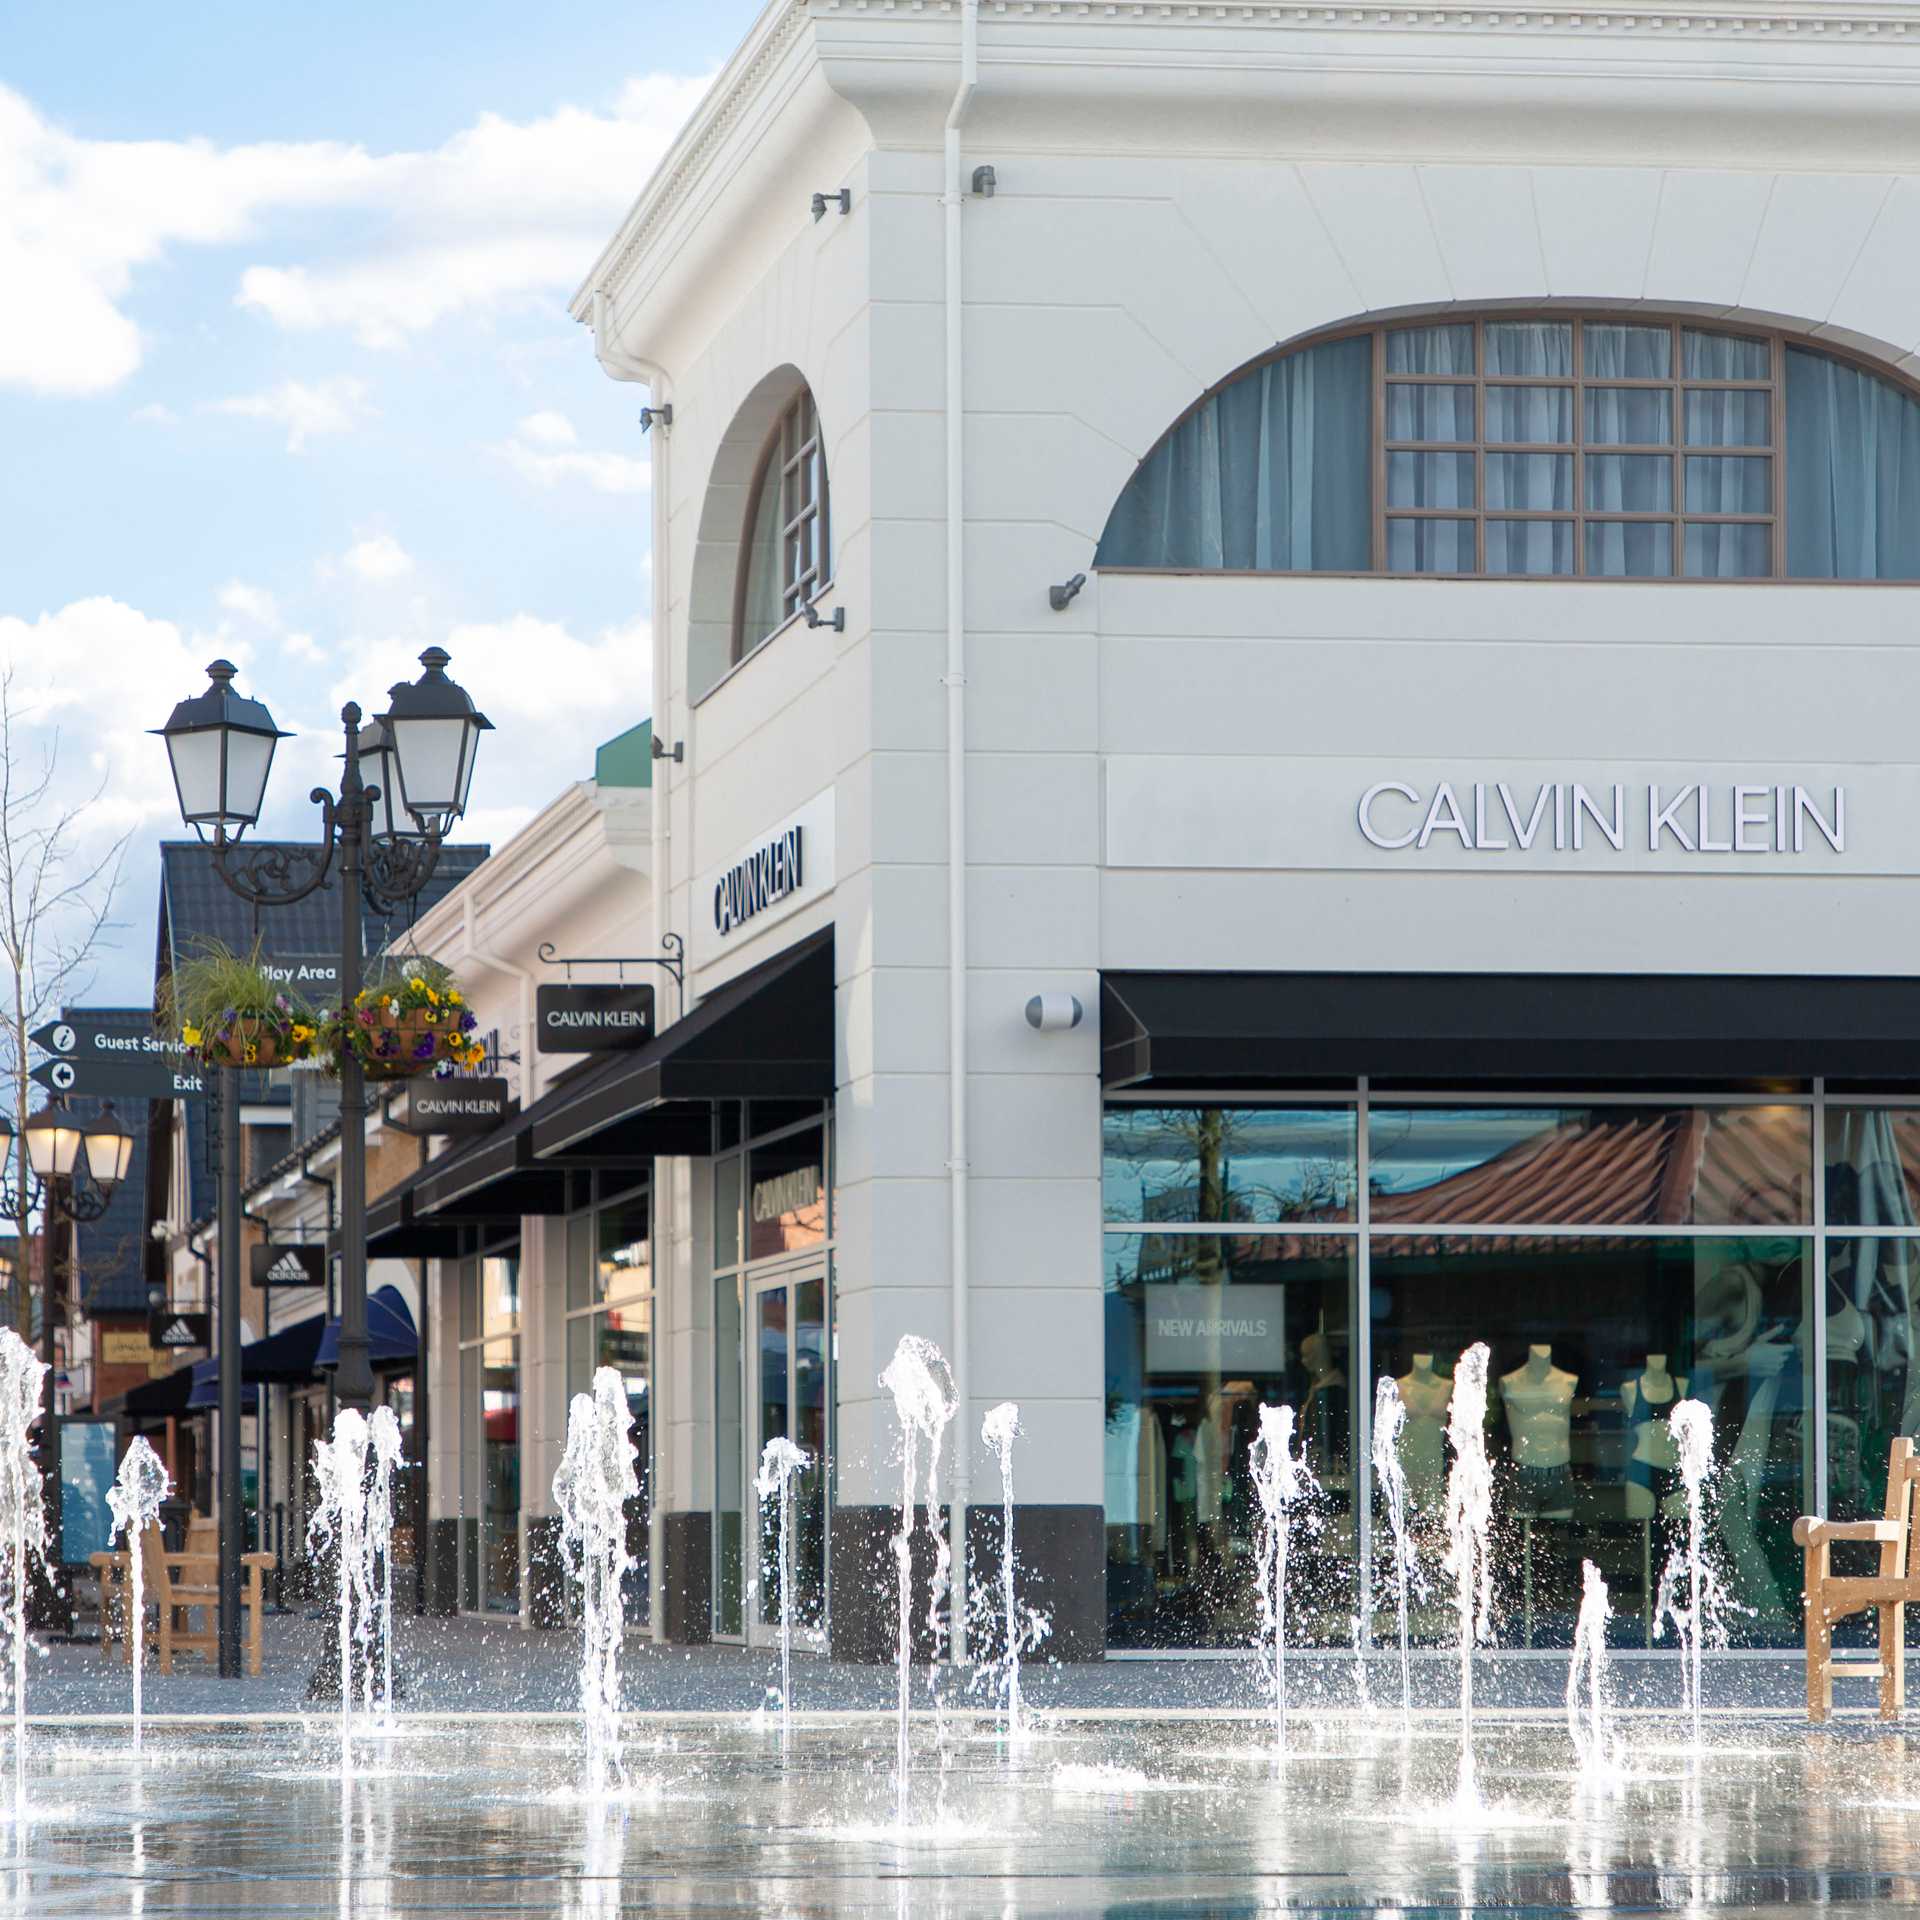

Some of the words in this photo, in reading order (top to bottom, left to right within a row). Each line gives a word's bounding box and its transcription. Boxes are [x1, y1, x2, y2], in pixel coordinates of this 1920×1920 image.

[1357, 780, 1623, 851] CALVIN
[1648, 783, 1845, 854] KLEIN
[259, 965, 294, 984] Play
[296, 965, 337, 980] Area
[547, 1011, 602, 1027] CALVIN
[604, 1011, 646, 1027] KLEIN
[94, 1033, 141, 1052] Guest
[142, 1036, 198, 1054] Servic
[173, 1075, 203, 1091] Exit
[416, 1099, 463, 1114] CALVIN
[464, 1099, 500, 1114] KLEIN
[266, 1270, 310, 1281] adidas
[1157, 1319, 1193, 1337] NEW
[1195, 1319, 1267, 1337] ARRIVALS
